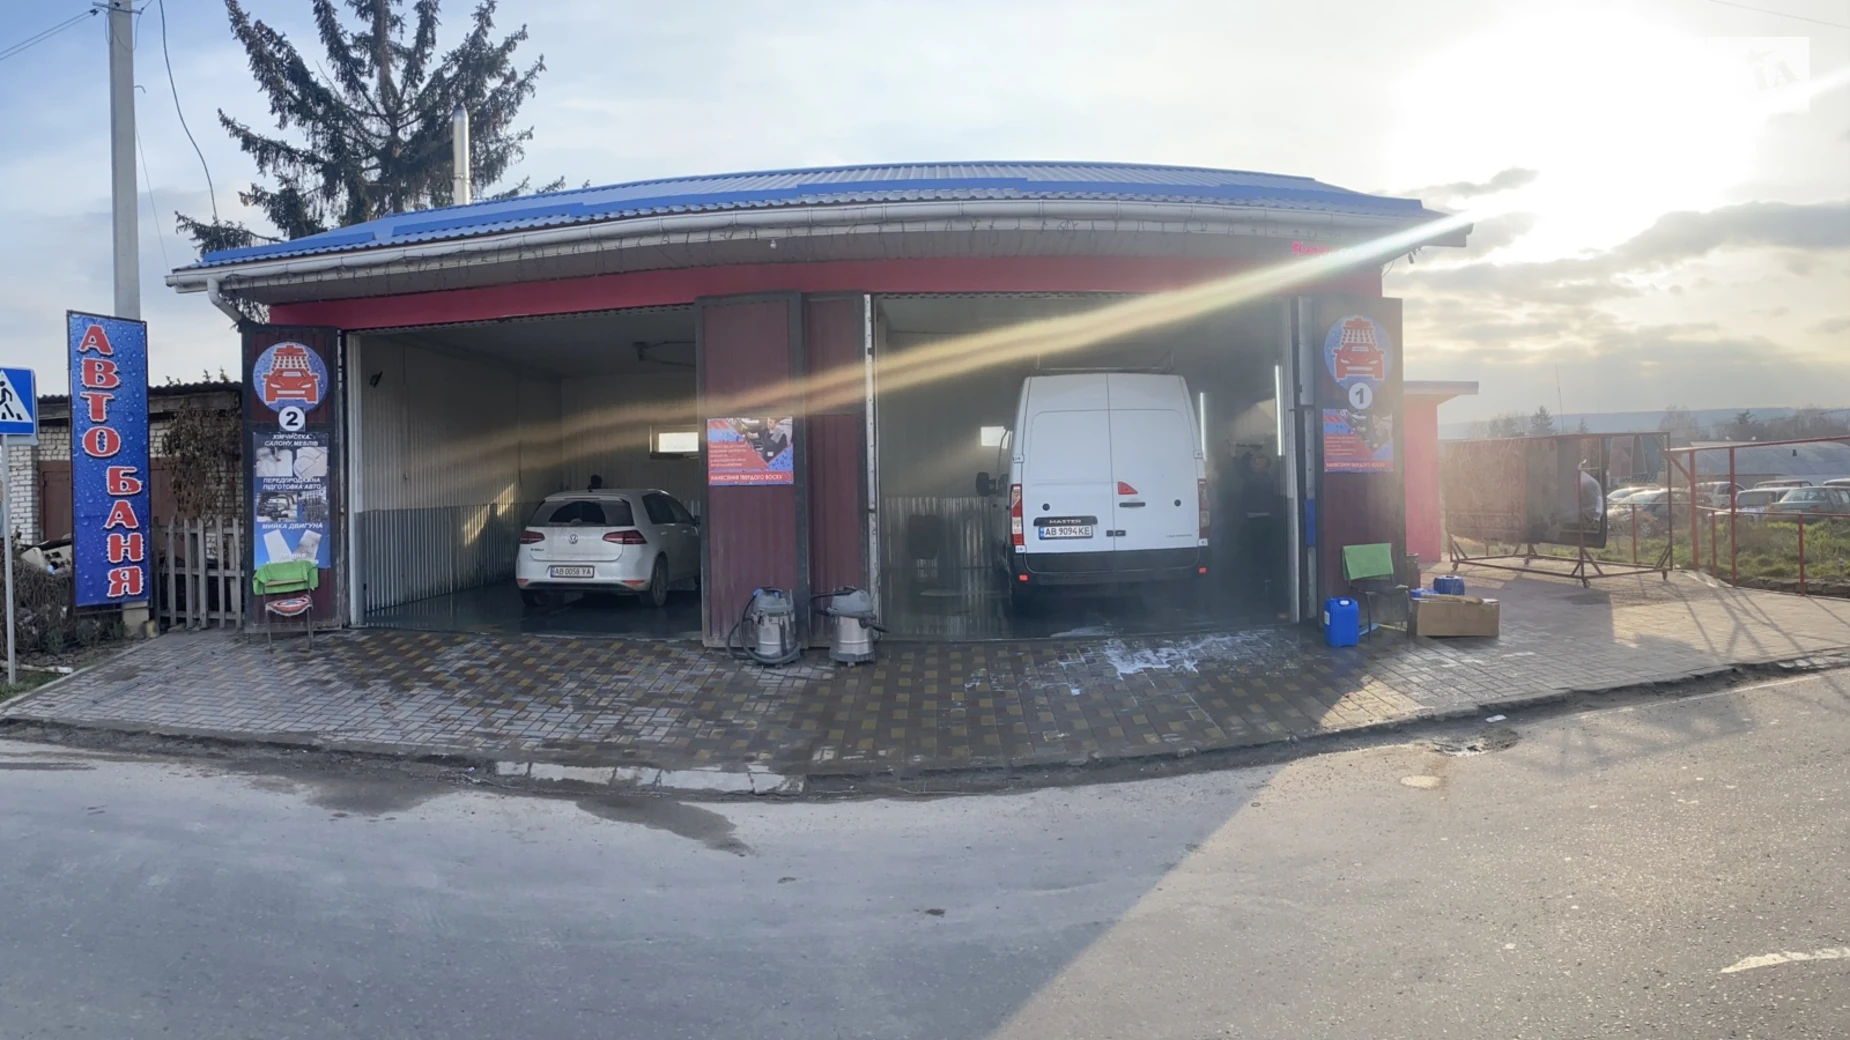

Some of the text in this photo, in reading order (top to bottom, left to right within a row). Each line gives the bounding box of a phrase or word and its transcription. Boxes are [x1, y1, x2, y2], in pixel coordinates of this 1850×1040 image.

[1355, 388, 1364, 405] 1
[286, 411, 298, 426] 2
[77, 324, 145, 598] АВТО БАНЯ
[1045, 526, 1090, 536] AB 9094 KE
